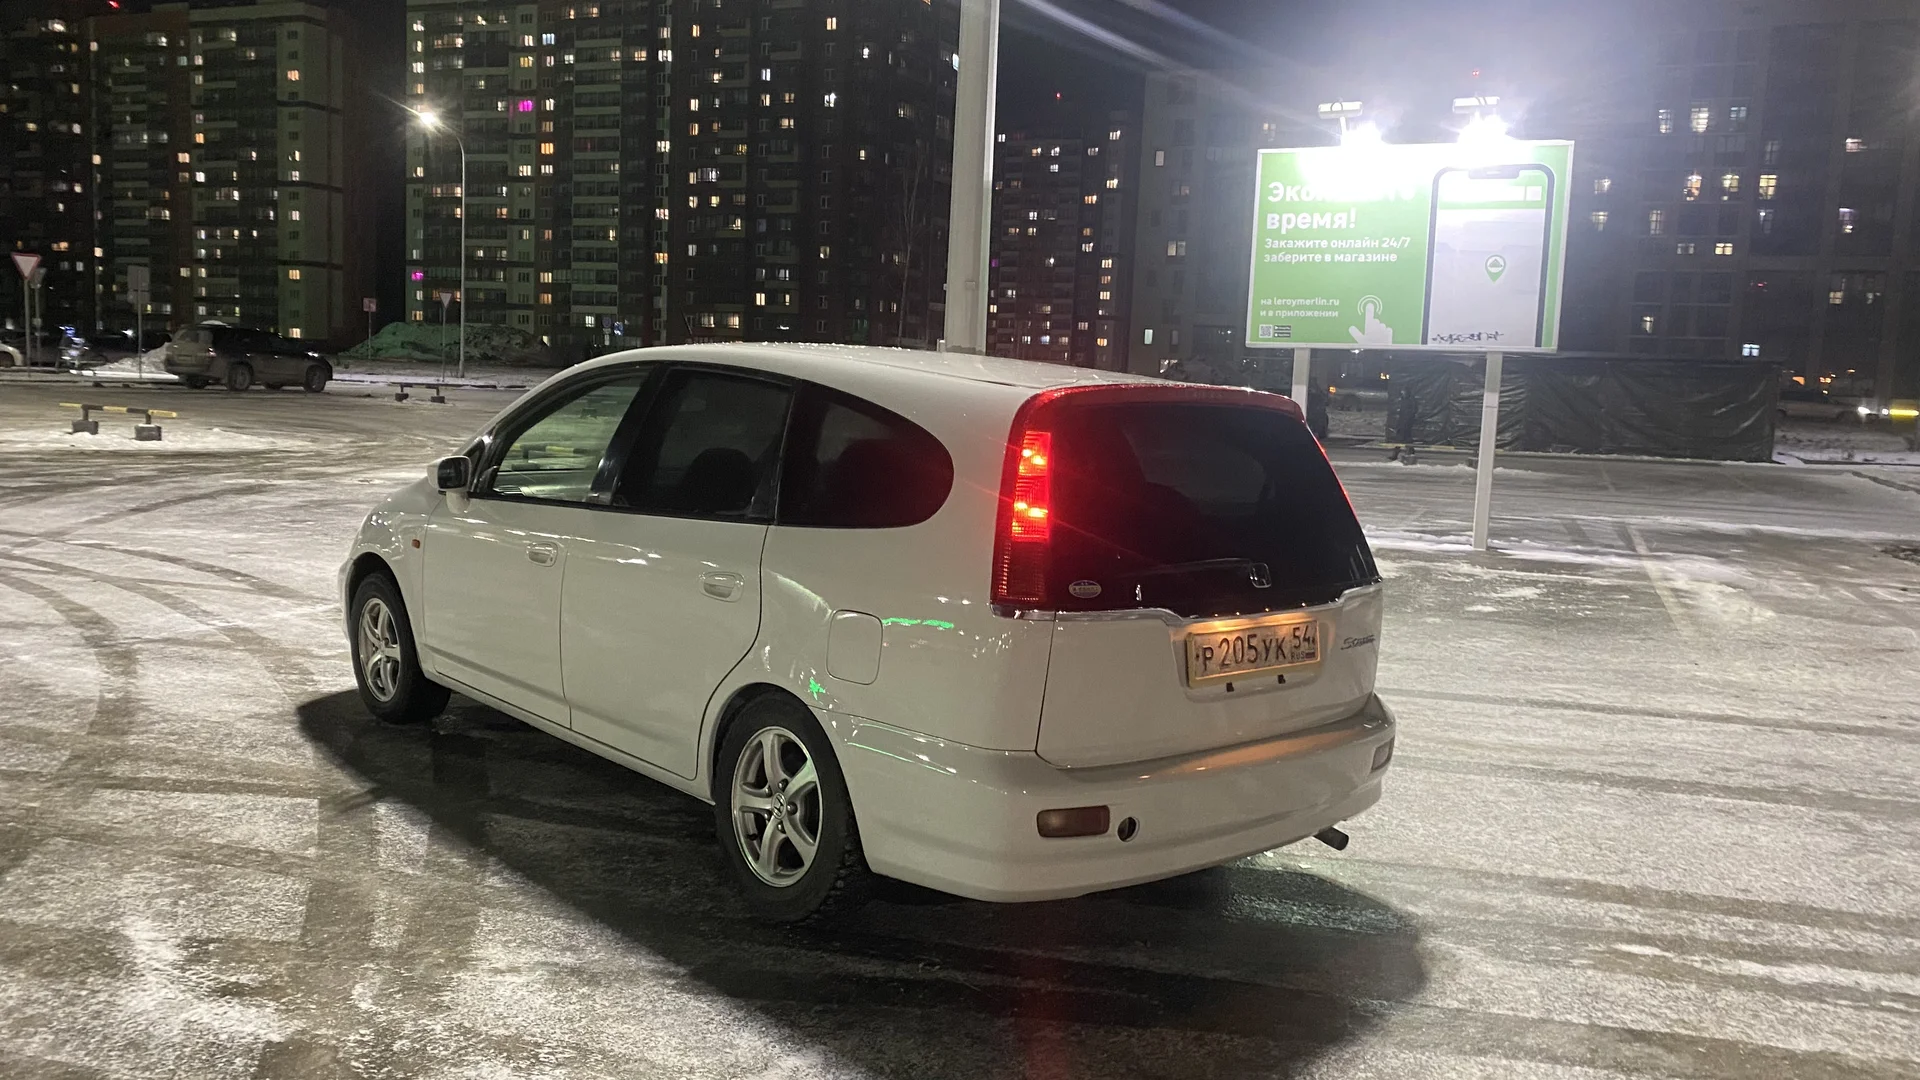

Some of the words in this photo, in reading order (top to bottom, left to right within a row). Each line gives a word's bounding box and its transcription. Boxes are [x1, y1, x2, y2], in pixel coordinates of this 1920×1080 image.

[1266, 207, 1357, 235] время!
[1264, 238, 1328, 249] Закажите
[1331, 236, 1379, 248] онлайн
[1381, 237, 1411, 249] 24/7
[1264, 251, 1322, 264] заберите
[1324, 253, 1331, 262] в
[1334, 253, 1398, 262] магазине
[1273, 297, 1340, 307] leroymerlin.ru
[1275, 310, 1339, 318] приложении
